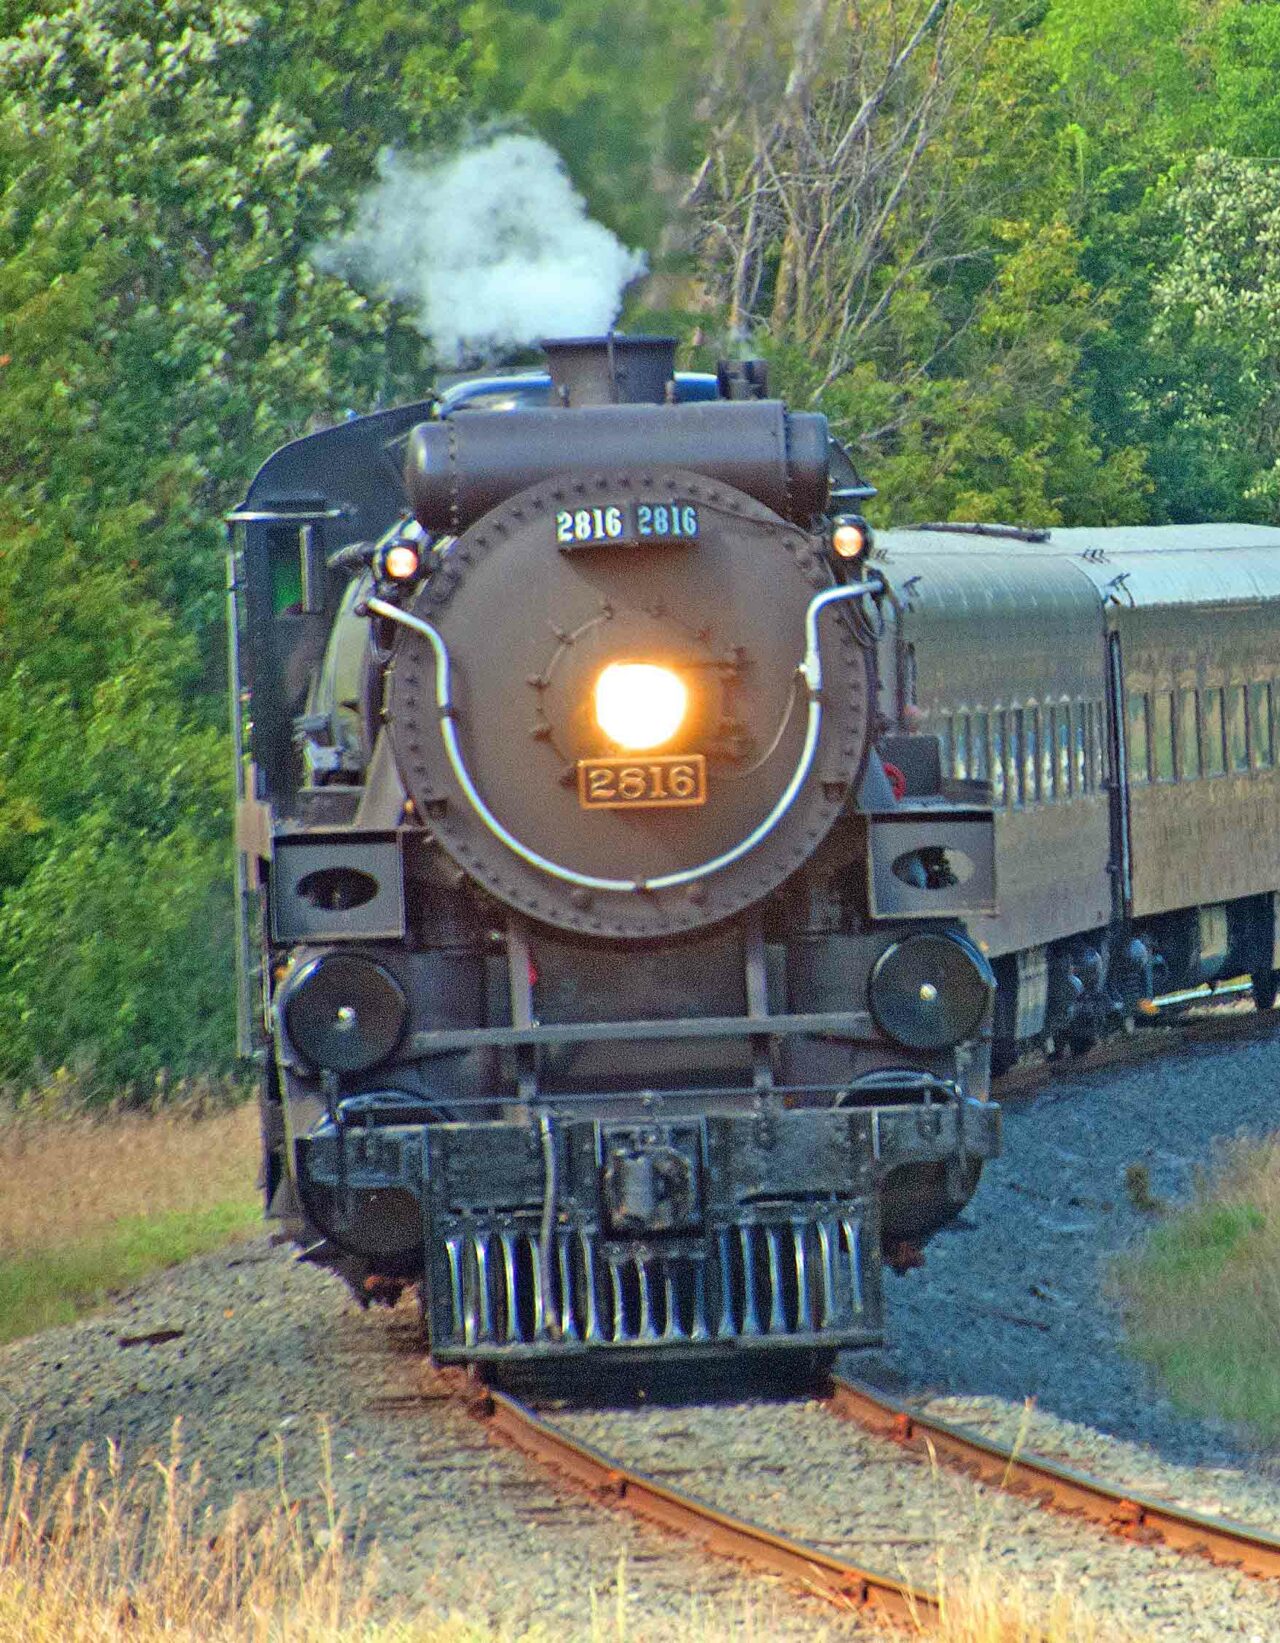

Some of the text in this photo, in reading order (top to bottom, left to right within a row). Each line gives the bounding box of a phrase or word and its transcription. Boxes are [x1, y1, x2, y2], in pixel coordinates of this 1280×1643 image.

[556, 504, 698, 542] 2816 2816
[588, 765, 696, 799] 2816
